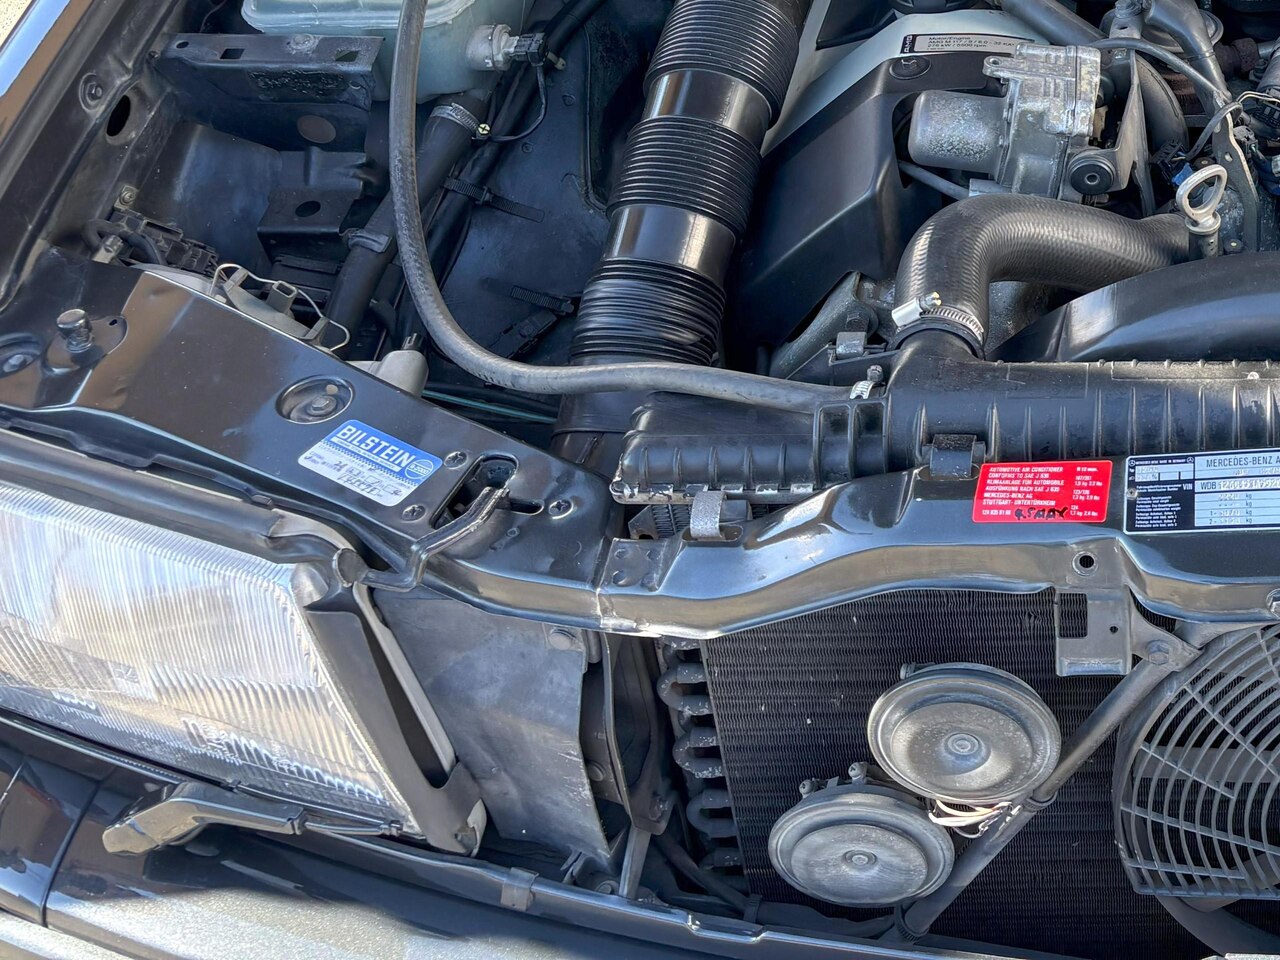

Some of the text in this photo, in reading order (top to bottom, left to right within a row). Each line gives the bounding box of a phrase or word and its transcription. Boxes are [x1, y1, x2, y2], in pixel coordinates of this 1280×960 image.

[335, 425, 416, 468] BILSTEIN
[1206, 456, 1273, 468] MERCEDES-BENZ
[1182, 483, 1193, 491] VIN
[1200, 481, 1217, 490] WDB
